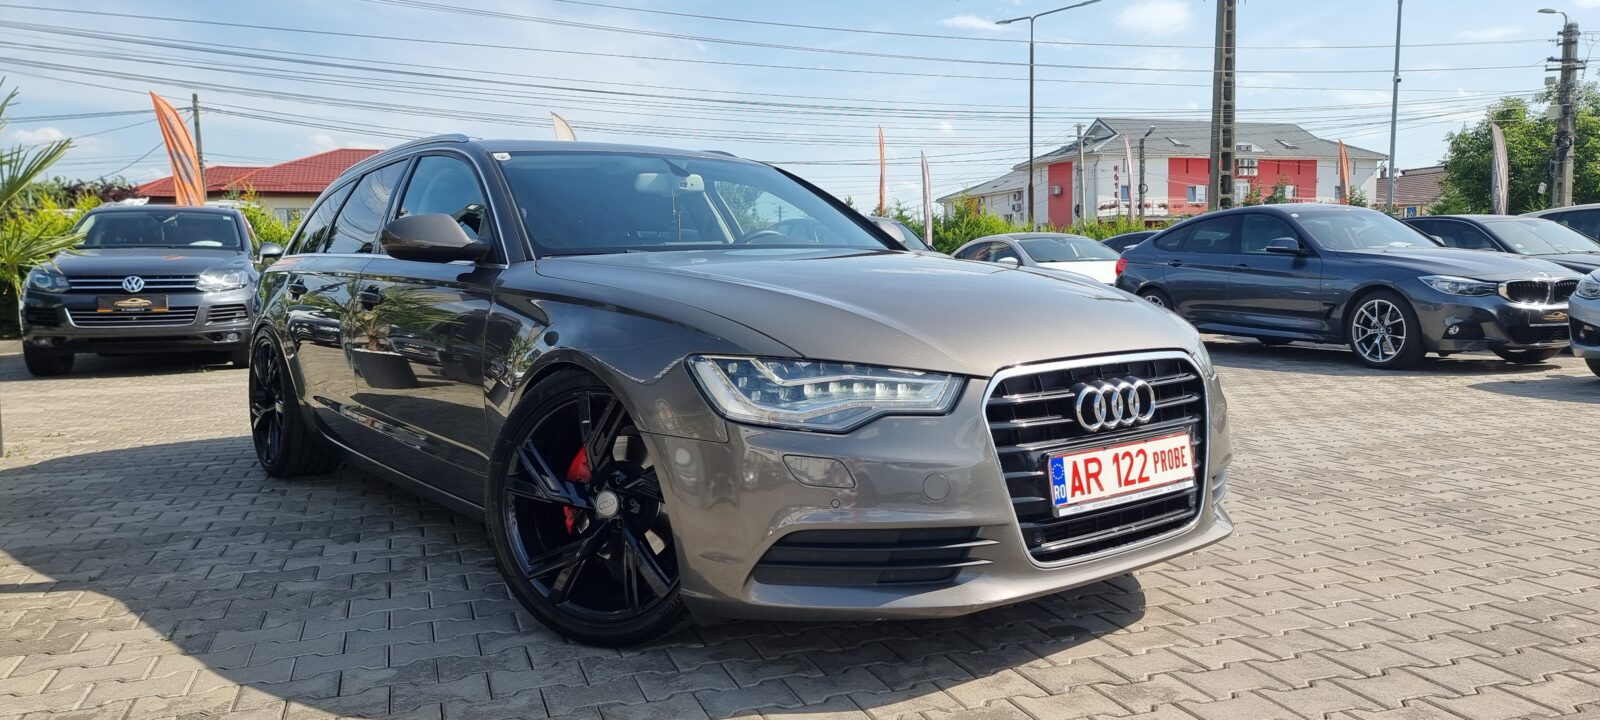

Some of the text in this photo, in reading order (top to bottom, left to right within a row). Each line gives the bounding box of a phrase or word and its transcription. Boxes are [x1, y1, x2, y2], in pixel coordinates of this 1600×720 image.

[1070, 445, 1188, 498] AR 122 PROBE
[1054, 484, 1066, 500] RO
